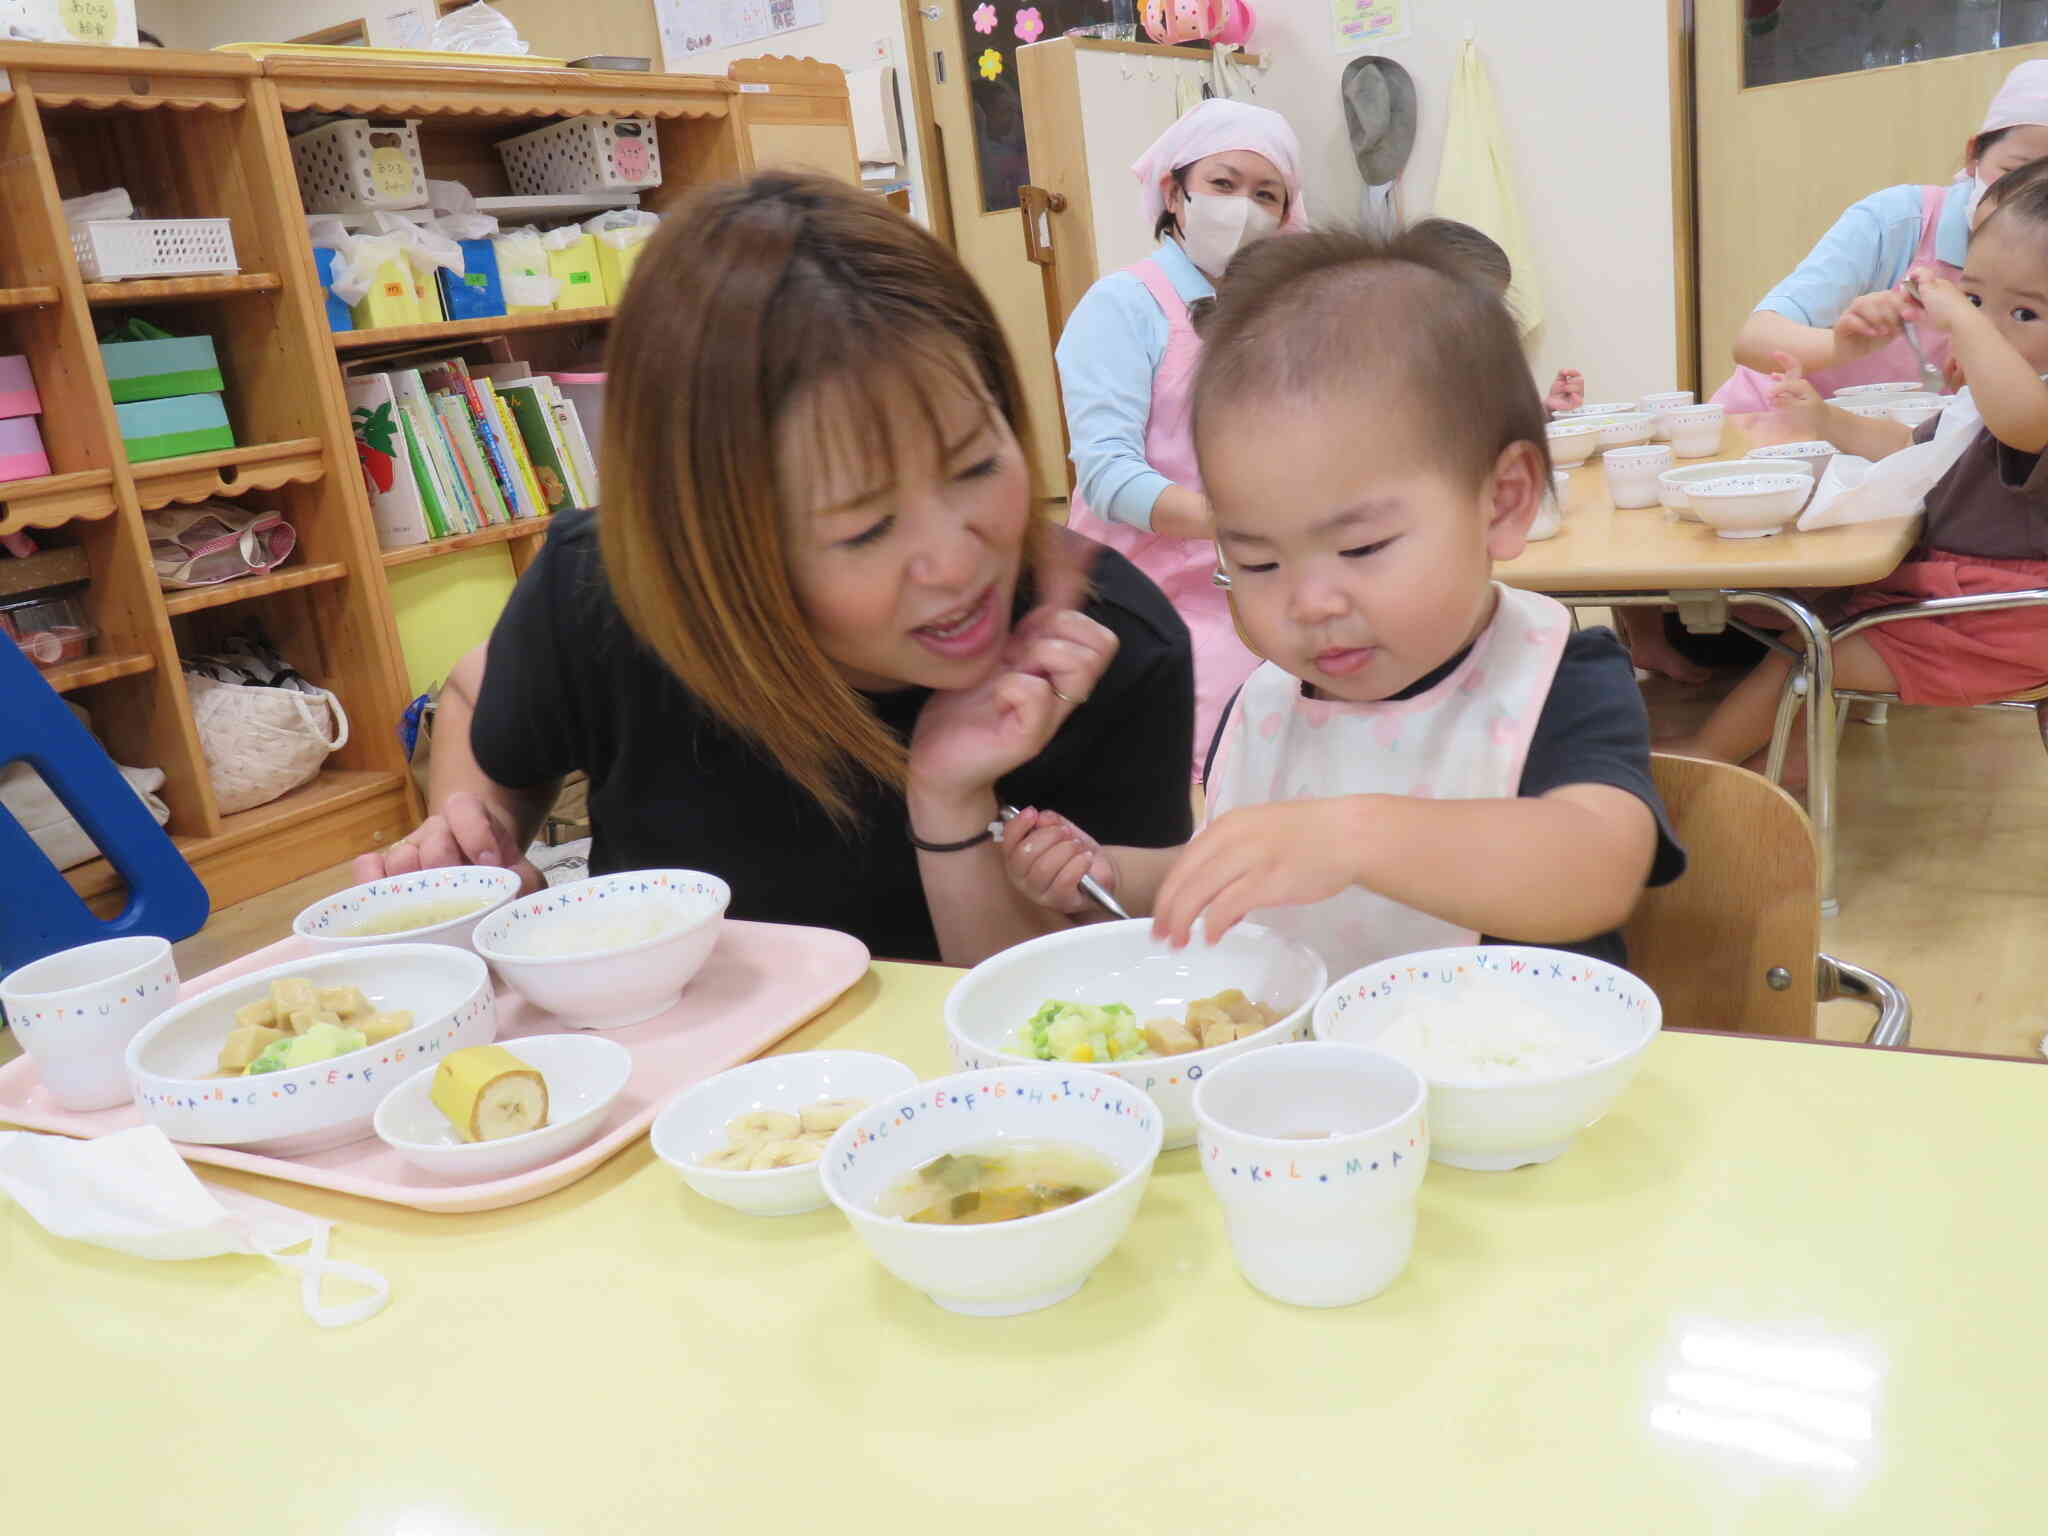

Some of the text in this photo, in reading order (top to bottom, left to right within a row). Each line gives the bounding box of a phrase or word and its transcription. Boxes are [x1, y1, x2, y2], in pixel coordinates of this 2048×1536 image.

[368, 885, 377, 897] V
[390, 884, 400, 894] W
[418, 879, 428, 889] X
[531, 904, 544, 916] W
[559, 894, 570, 907] X
[1382, 982, 1392, 995] S
[1407, 968, 1417, 984] T
[1441, 969, 1453, 983] U
[1477, 954, 1487, 967] V
[1510, 959, 1527, 974] W
[1551, 964, 1561, 978] X
[22, 1015, 31, 1027] S
[56, 1008, 65, 1024] T
[98, 1002, 110, 1016] U
[135, 984, 145, 997] V
[247, 1092, 257, 1104] C
[283, 1083, 297, 1095] D
[327, 1070, 337, 1084] E
[363, 1068, 373, 1082] F
[431, 1039, 440, 1052] H
[1145, 1077, 1155, 1091] P
[1187, 1065, 1203, 1080] Q
[879, 1121, 888, 1137] C
[900, 1107, 914, 1120] D
[935, 1092, 946, 1108] E
[964, 1094, 975, 1110] F
[994, 1081, 1006, 1097] G
[1029, 1088, 1042, 1103] H
[1062, 1081, 1071, 1096] I
[1089, 1088, 1100, 1102] J
[1115, 1100, 1122, 1114] K
[1251, 1166, 1262, 1182] K
[1289, 1160, 1304, 1179] L
[1346, 1158, 1362, 1175] M
